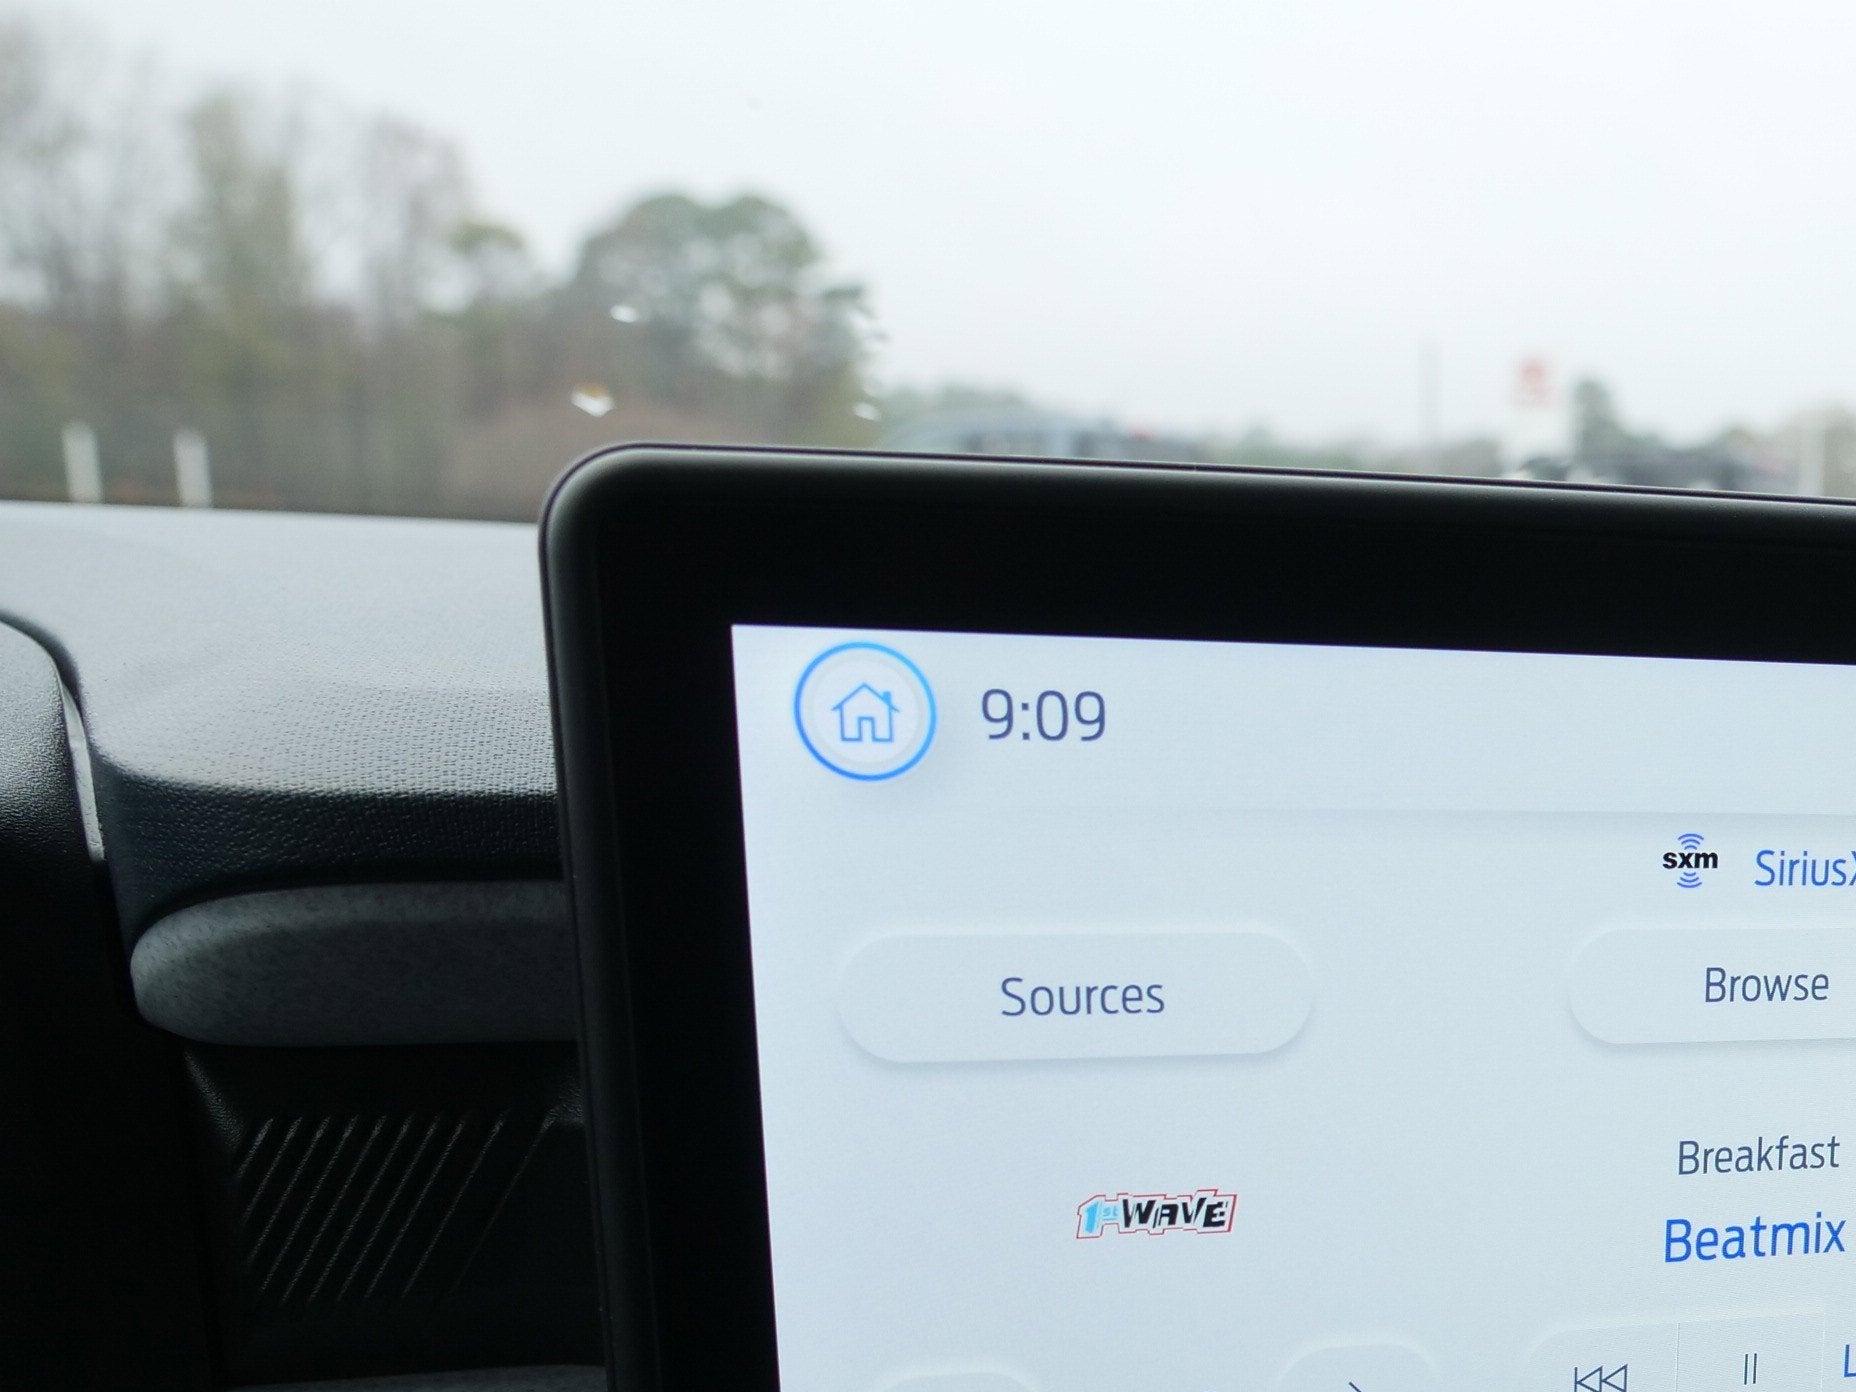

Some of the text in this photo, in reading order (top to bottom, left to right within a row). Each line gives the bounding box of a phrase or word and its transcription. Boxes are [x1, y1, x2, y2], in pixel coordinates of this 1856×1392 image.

[980, 688, 1107, 742] 9:09
[1662, 849, 1718, 870] sxm
[1000, 976, 1166, 1017] Sources
[1704, 966, 1830, 1003] Browse
[1677, 1134, 1841, 1175] Breakfast
[1122, 1197, 1228, 1228] WAVE
[1664, 1211, 1847, 1263] Beatmix
